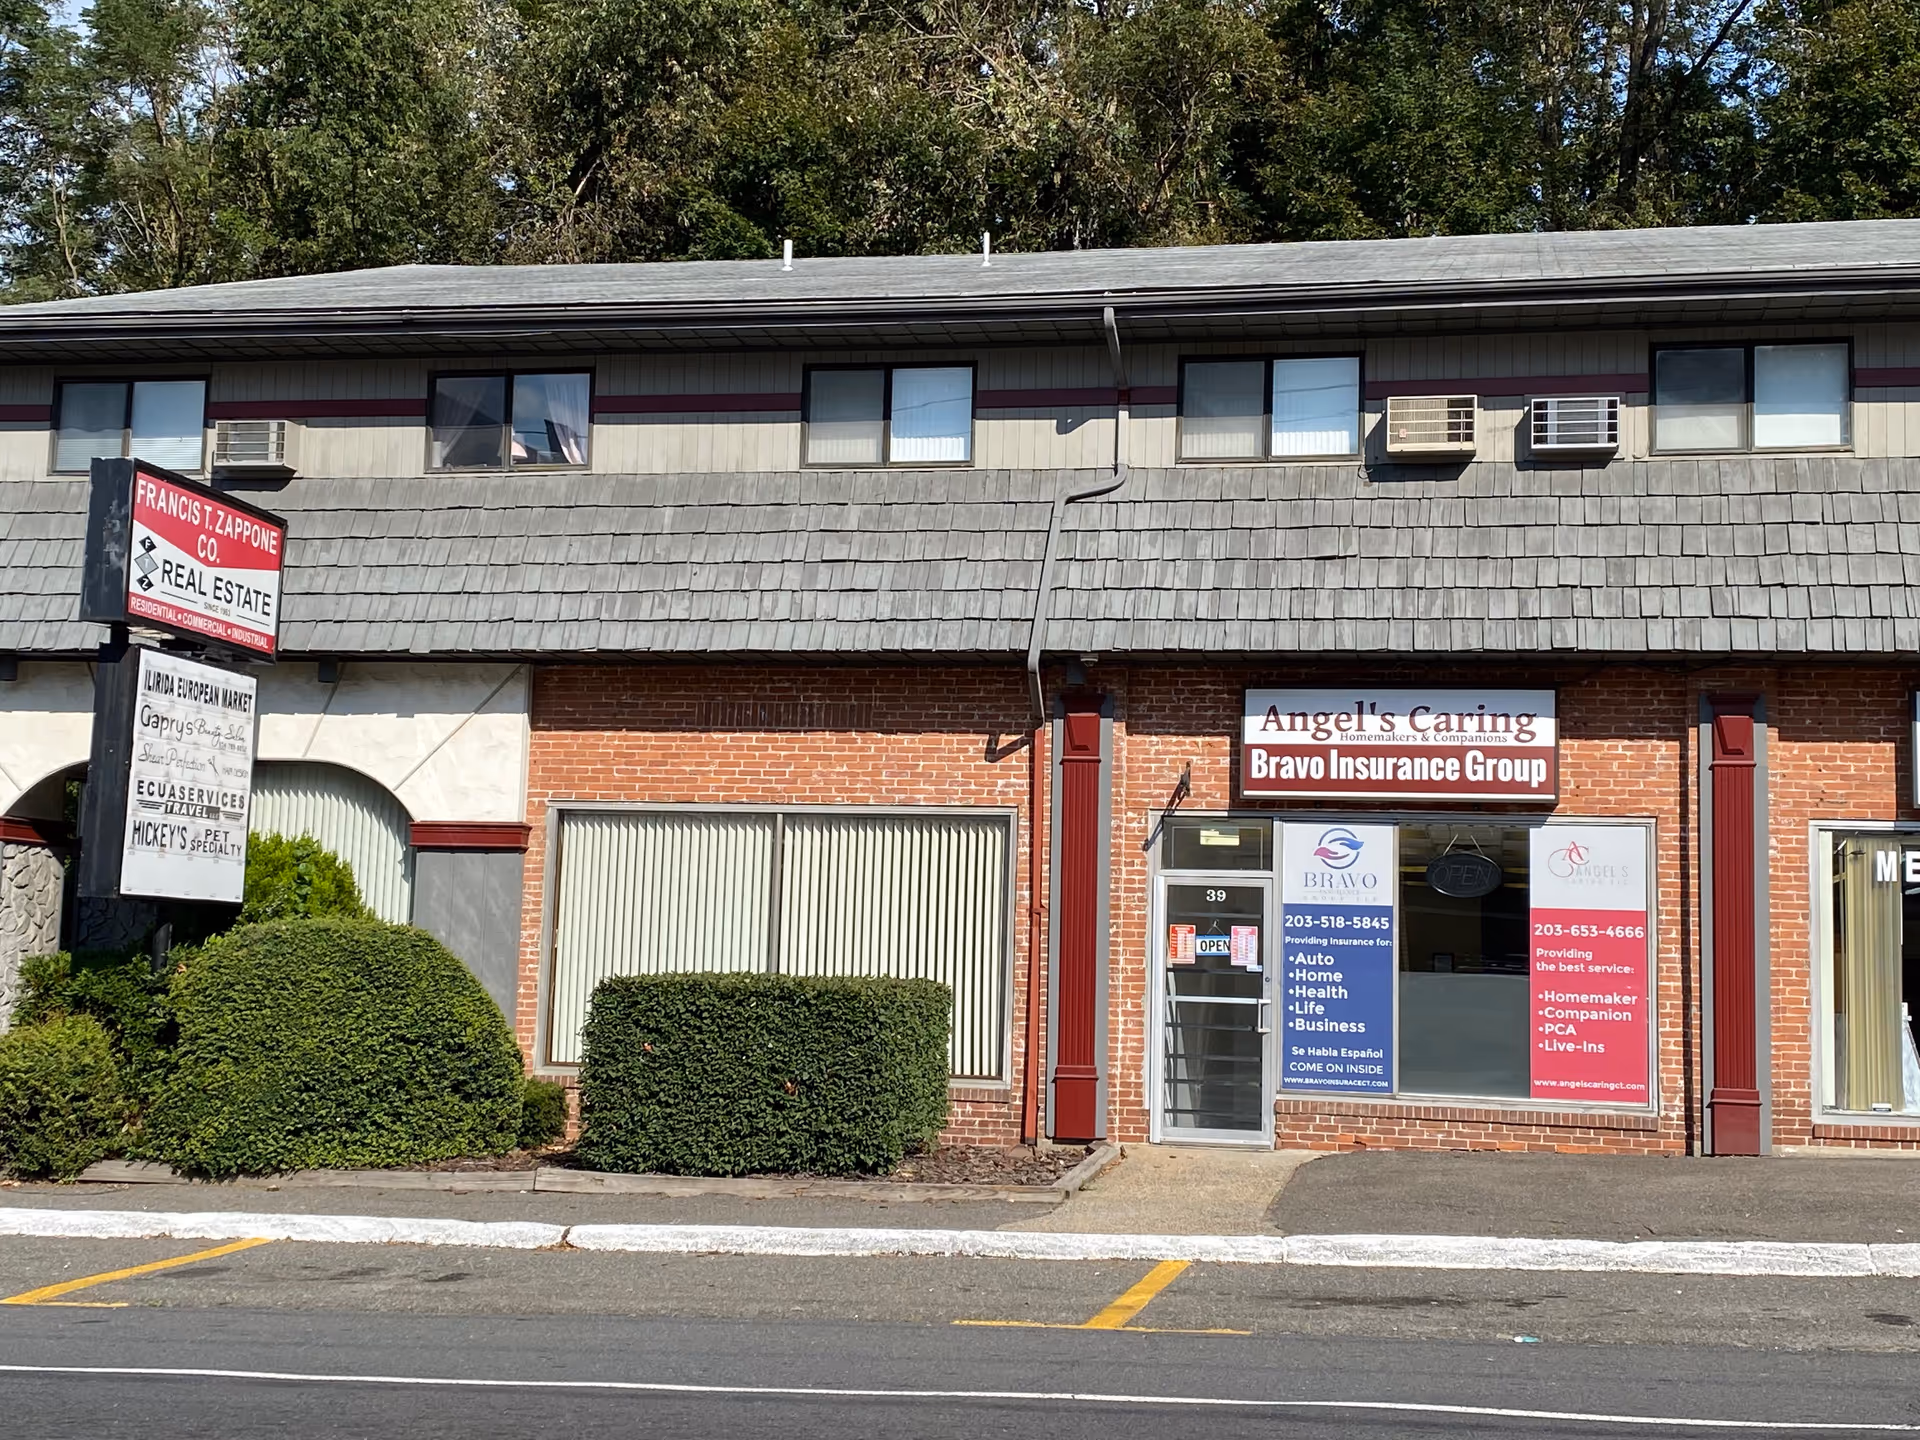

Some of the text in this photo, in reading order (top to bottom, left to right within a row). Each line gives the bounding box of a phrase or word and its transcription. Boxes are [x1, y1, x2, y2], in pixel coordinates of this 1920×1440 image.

[136, 479, 278, 555] FRANCIS T. ZAPPONE
[197, 534, 220, 564] CO.
[161, 559, 272, 617] REAL ESTATE
[131, 597, 268, 649] RESIDENTIAL COMMERCIAL INDUSTRIAL
[144, 669, 253, 713] ILIRIDA EUROPEAN MARKET
[140, 704, 193, 742] Gapry's
[1260, 700, 1537, 743] Angel's Caring
[1339, 732, 1508, 746] Homemakers & Companions
[1250, 749, 1547, 788] Bravo Insurance Group
[137, 780, 245, 810] ECUASERVICES
[166, 801, 209, 818] TRAVEL
[205, 828, 230, 843] PET
[190, 839, 242, 857] SPECIALTY
[1304, 872, 1377, 889] BRAVO
[1433, 864, 1492, 887] OPEN
[1206, 889, 1226, 902] 39
[1284, 915, 1389, 929] 203-518-5845
[1534, 923, 1644, 939] 203-653-4666
[1200, 940, 1231, 952] OPEN
[1285, 936, 1392, 947] Providing Insurance for:
[1295, 952, 1334, 965] Auto
[1536, 947, 1593, 961] Providing
[1295, 968, 1343, 982] Home
[1536, 961, 1635, 974] the best service:
[1295, 985, 1348, 999] Health
[1544, 990, 1638, 1005] Homemaker
[1295, 1001, 1325, 1015] Life
[1544, 1006, 1632, 1022] Companion
[1295, 1018, 1366, 1033] Business
[1544, 1023, 1577, 1036] PCA
[1292, 1046, 1383, 1060] Se Habla Español
[1544, 1039, 1605, 1053] Live-Ins
[1289, 1062, 1384, 1075] COME ON INSIDE
[1533, 1079, 1645, 1091] www.angelscaringct.com
